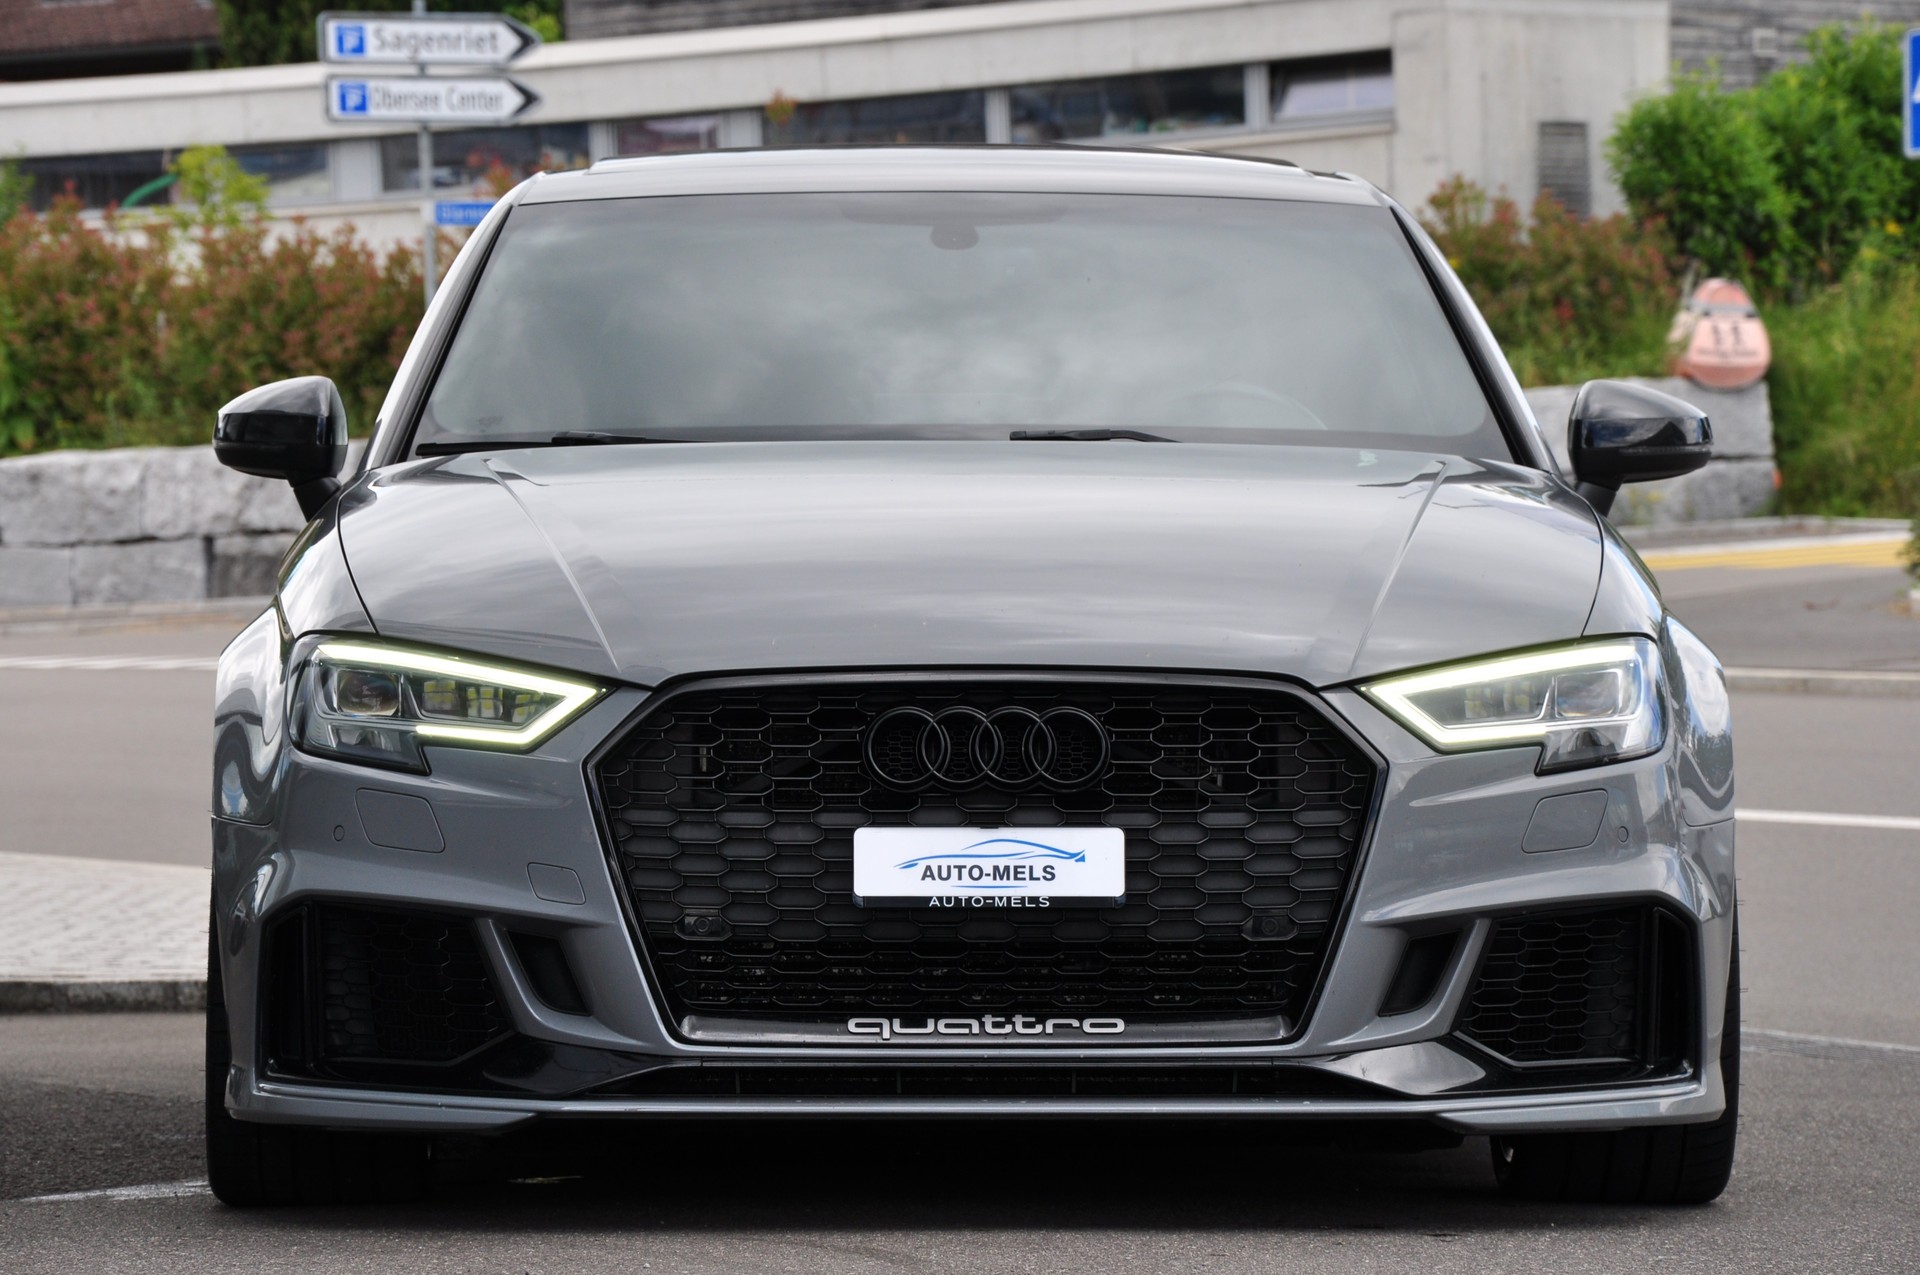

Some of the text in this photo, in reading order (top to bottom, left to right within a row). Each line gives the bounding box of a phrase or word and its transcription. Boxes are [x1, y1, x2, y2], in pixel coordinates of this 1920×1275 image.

[373, 26, 499, 61] Sagenriet
[373, 85, 441, 112] Obersee
[446, 85, 504, 112] Center
[920, 864, 1056, 882] AUTO-MELS
[928, 895, 1051, 908] AUTO-MELS
[847, 1014, 1126, 1040] quattro
